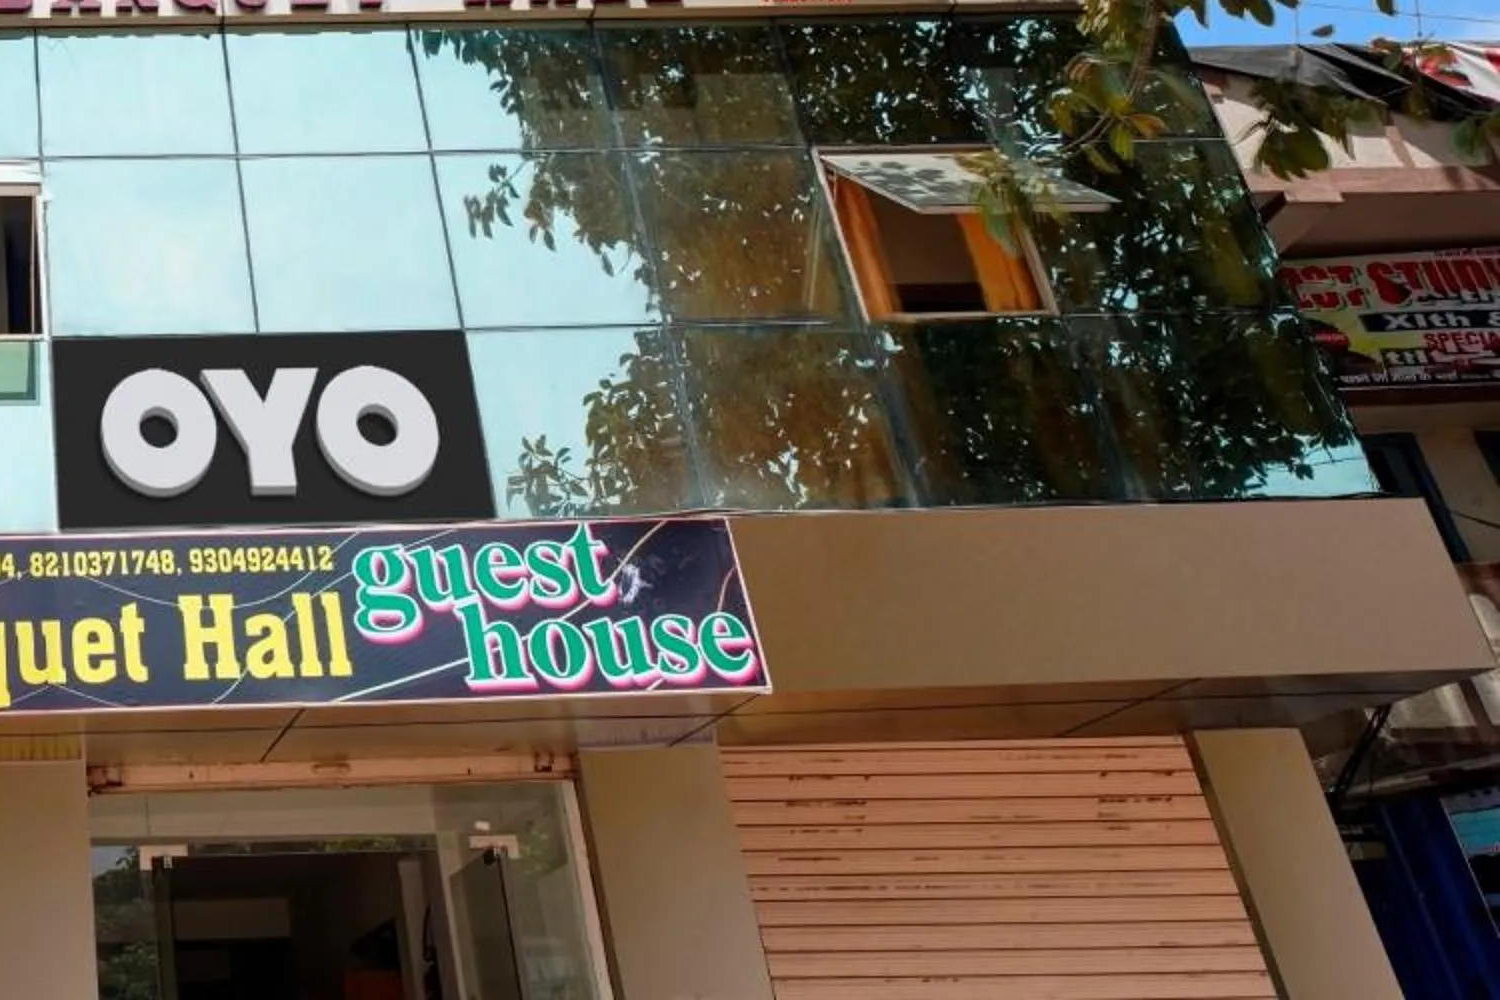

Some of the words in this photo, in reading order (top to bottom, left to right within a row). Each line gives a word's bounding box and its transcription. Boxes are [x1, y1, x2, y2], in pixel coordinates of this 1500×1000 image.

[101, 364, 440, 498] OYO
[30, 549, 182, 577] 8210371748,
[189, 545, 334, 573] 9304924412
[352, 521, 618, 644] guest
[177, 591, 353, 681] Hall
[453, 601, 759, 692] house
